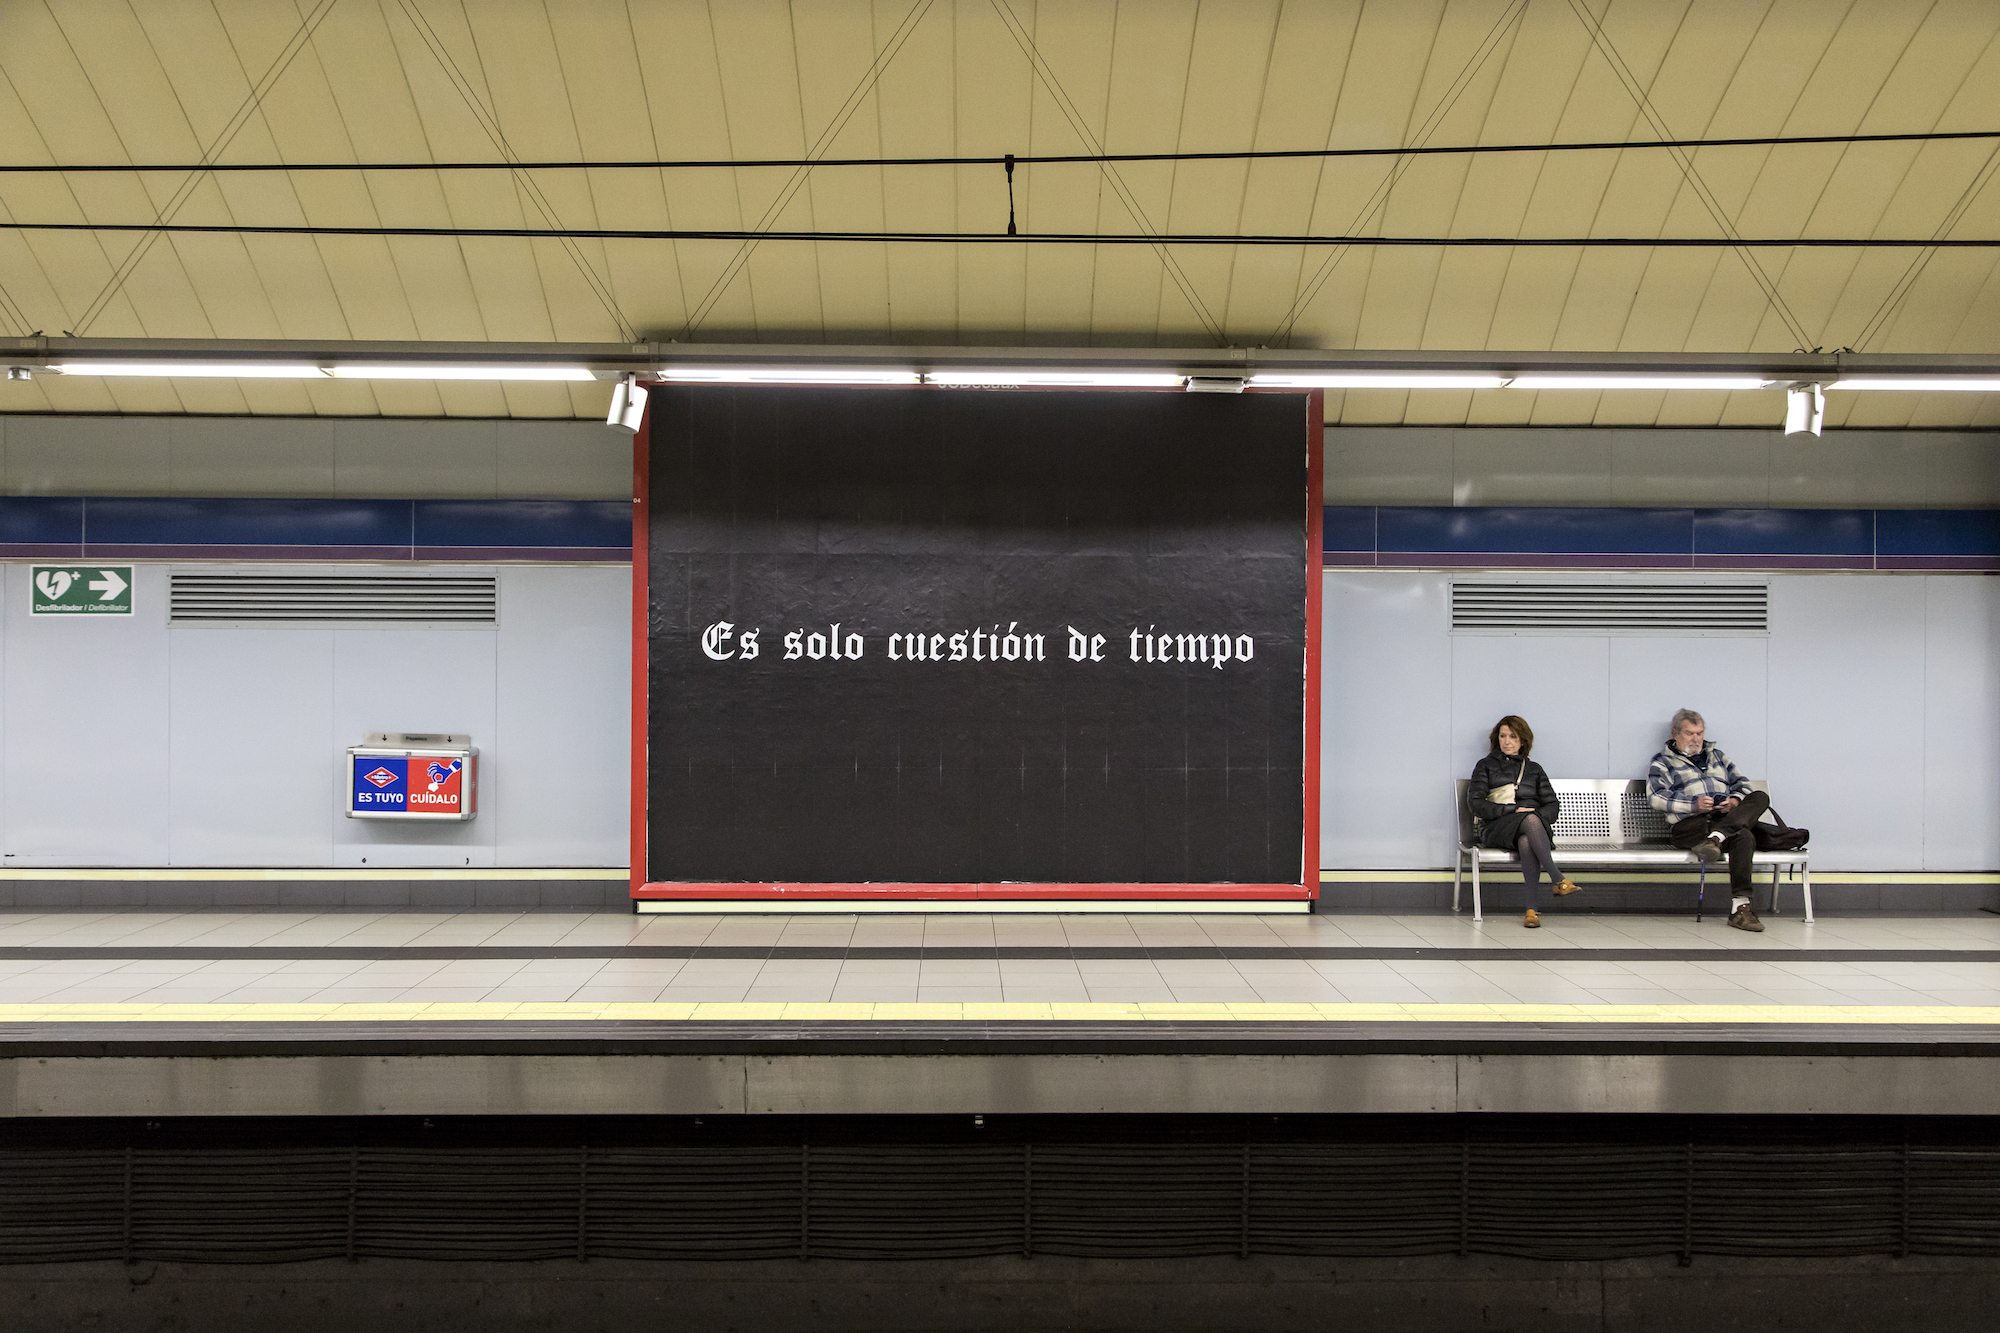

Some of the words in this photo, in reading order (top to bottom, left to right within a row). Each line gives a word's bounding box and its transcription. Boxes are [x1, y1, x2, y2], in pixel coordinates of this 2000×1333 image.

[702, 621, 759, 661] Es
[783, 623, 863, 661] solo
[888, 622, 1046, 662] cuestión
[1068, 625, 1106, 662] de
[1130, 625, 1254, 670] tiempo
[358, 792, 372, 803] ES
[374, 793, 404, 803] TUYO
[410, 791, 458, 804] CUÍDALO
